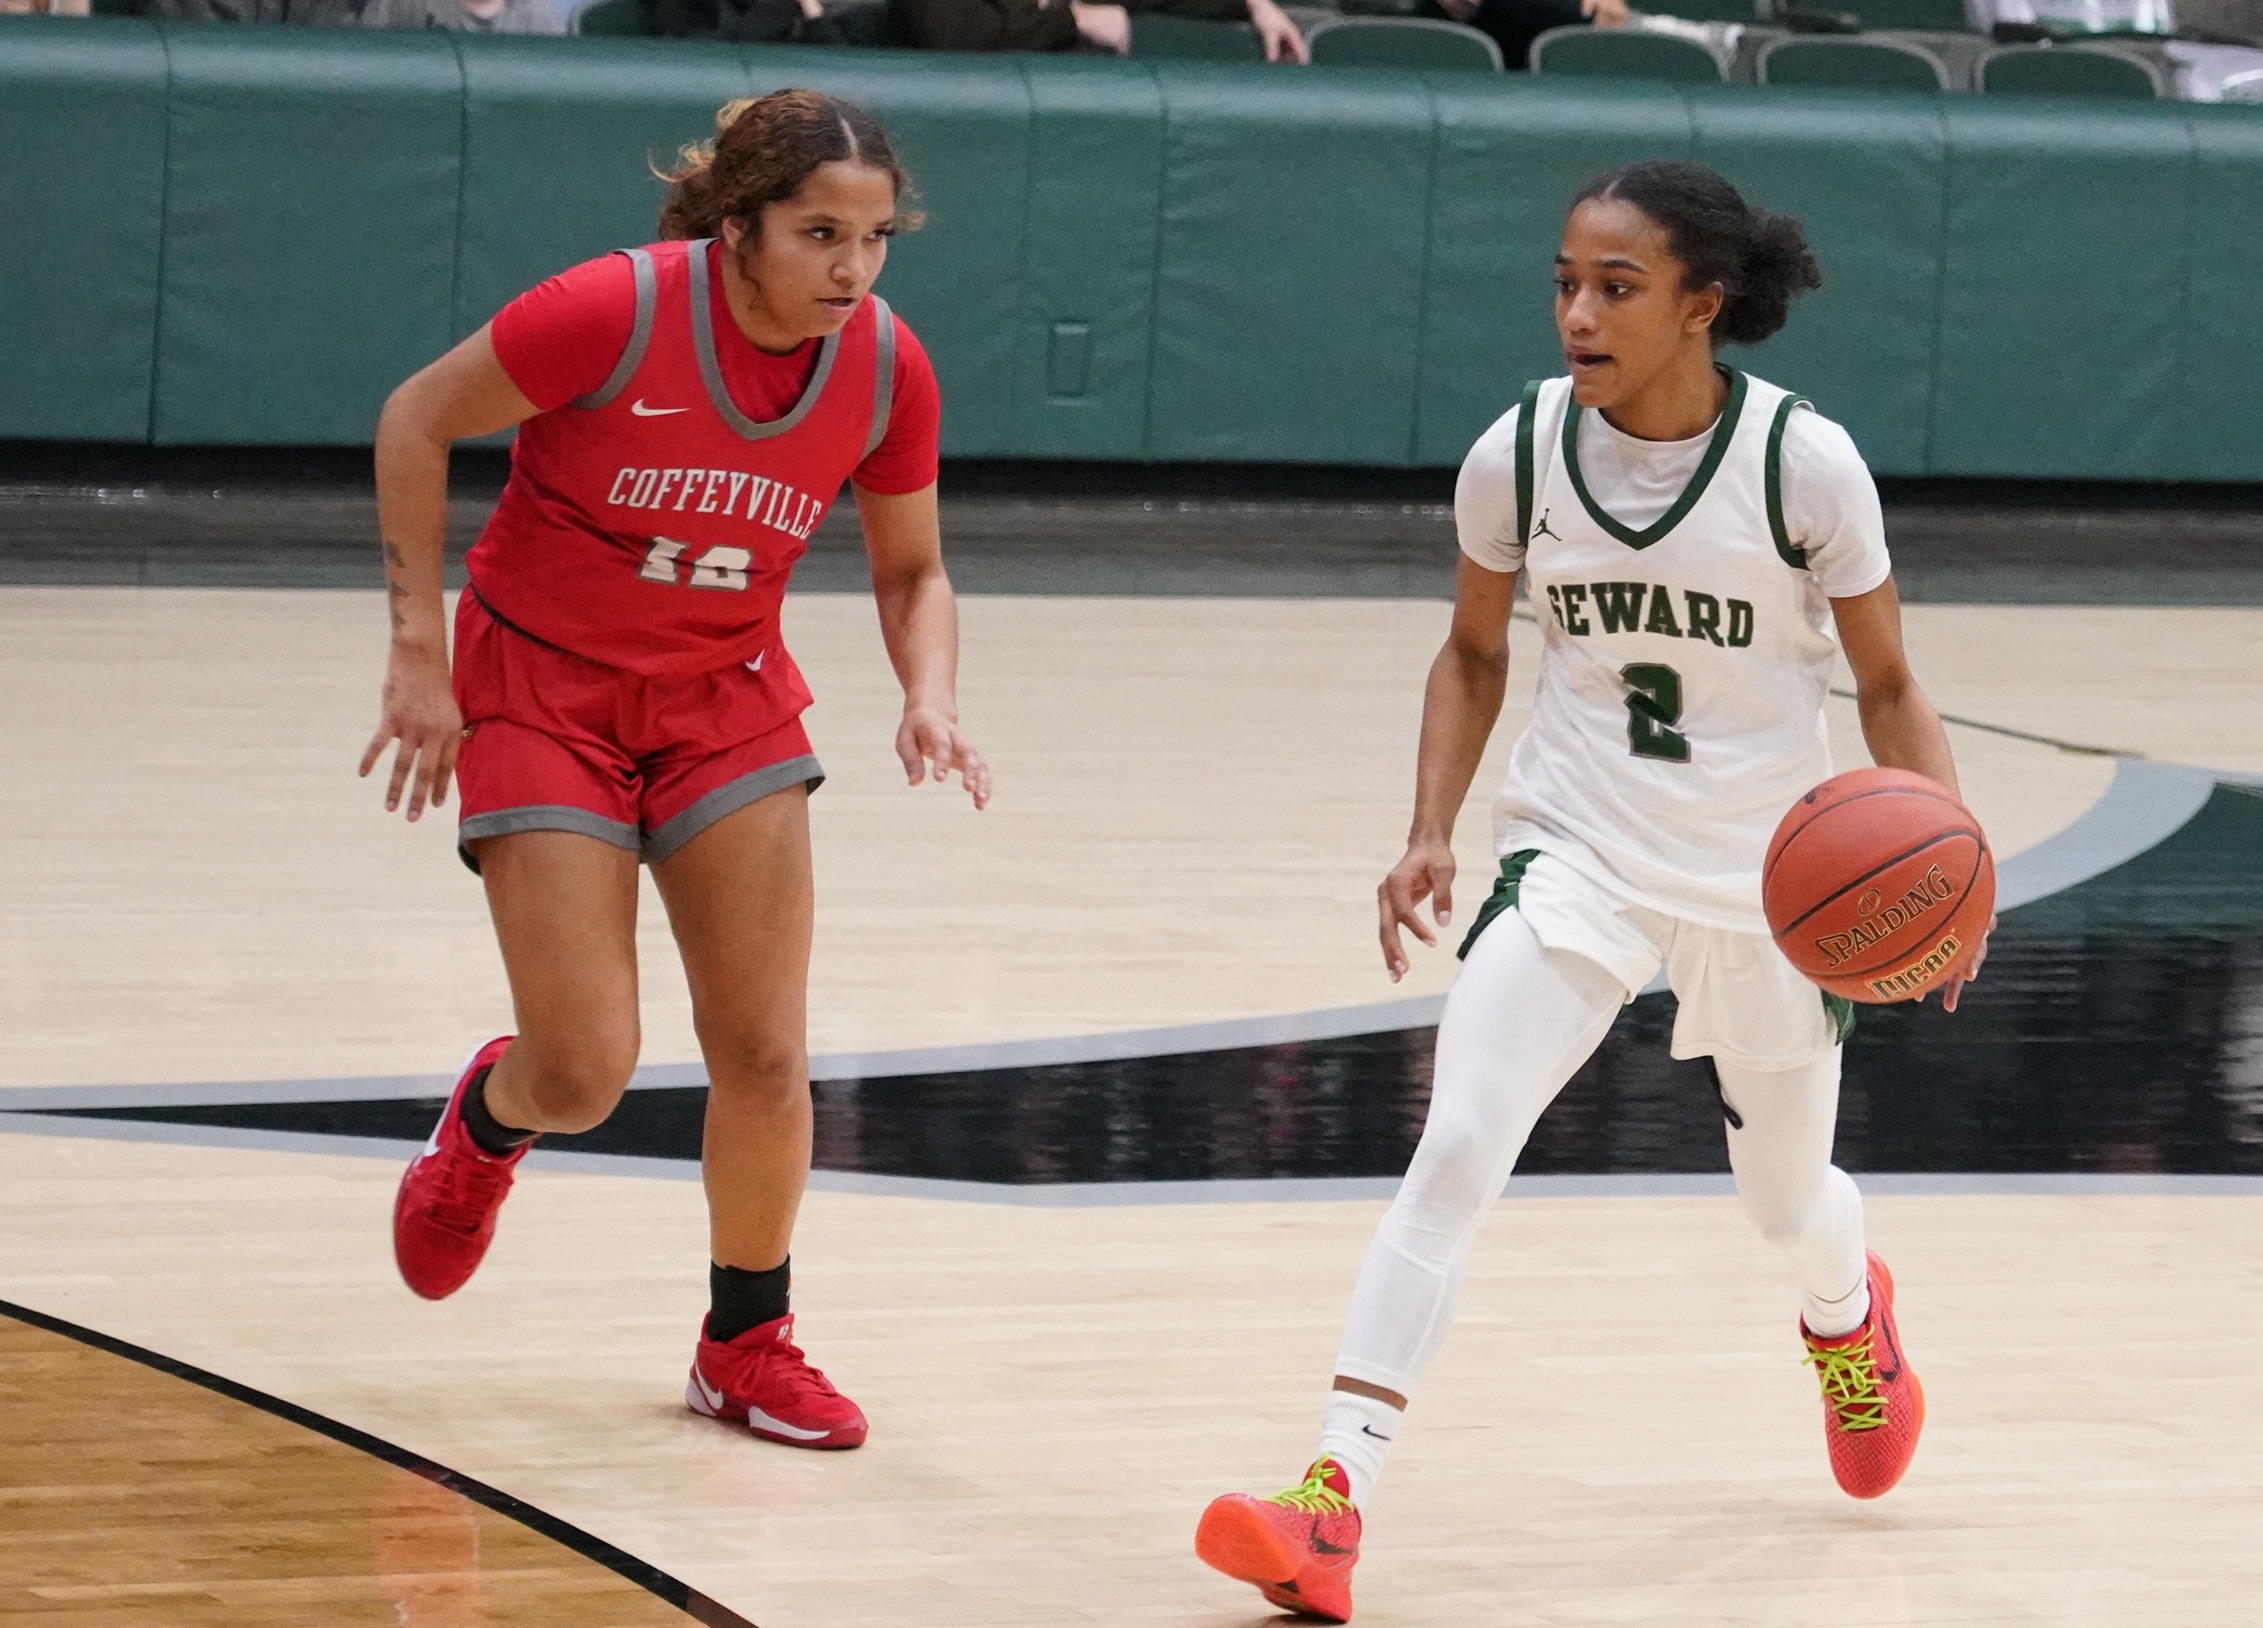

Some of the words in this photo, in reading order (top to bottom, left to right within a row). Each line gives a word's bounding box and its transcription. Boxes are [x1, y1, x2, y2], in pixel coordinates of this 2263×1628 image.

[607, 467, 822, 540] COFFEYVILLE
[1618, 662, 1692, 764] 2
[1814, 863, 1954, 968] SPALDING
